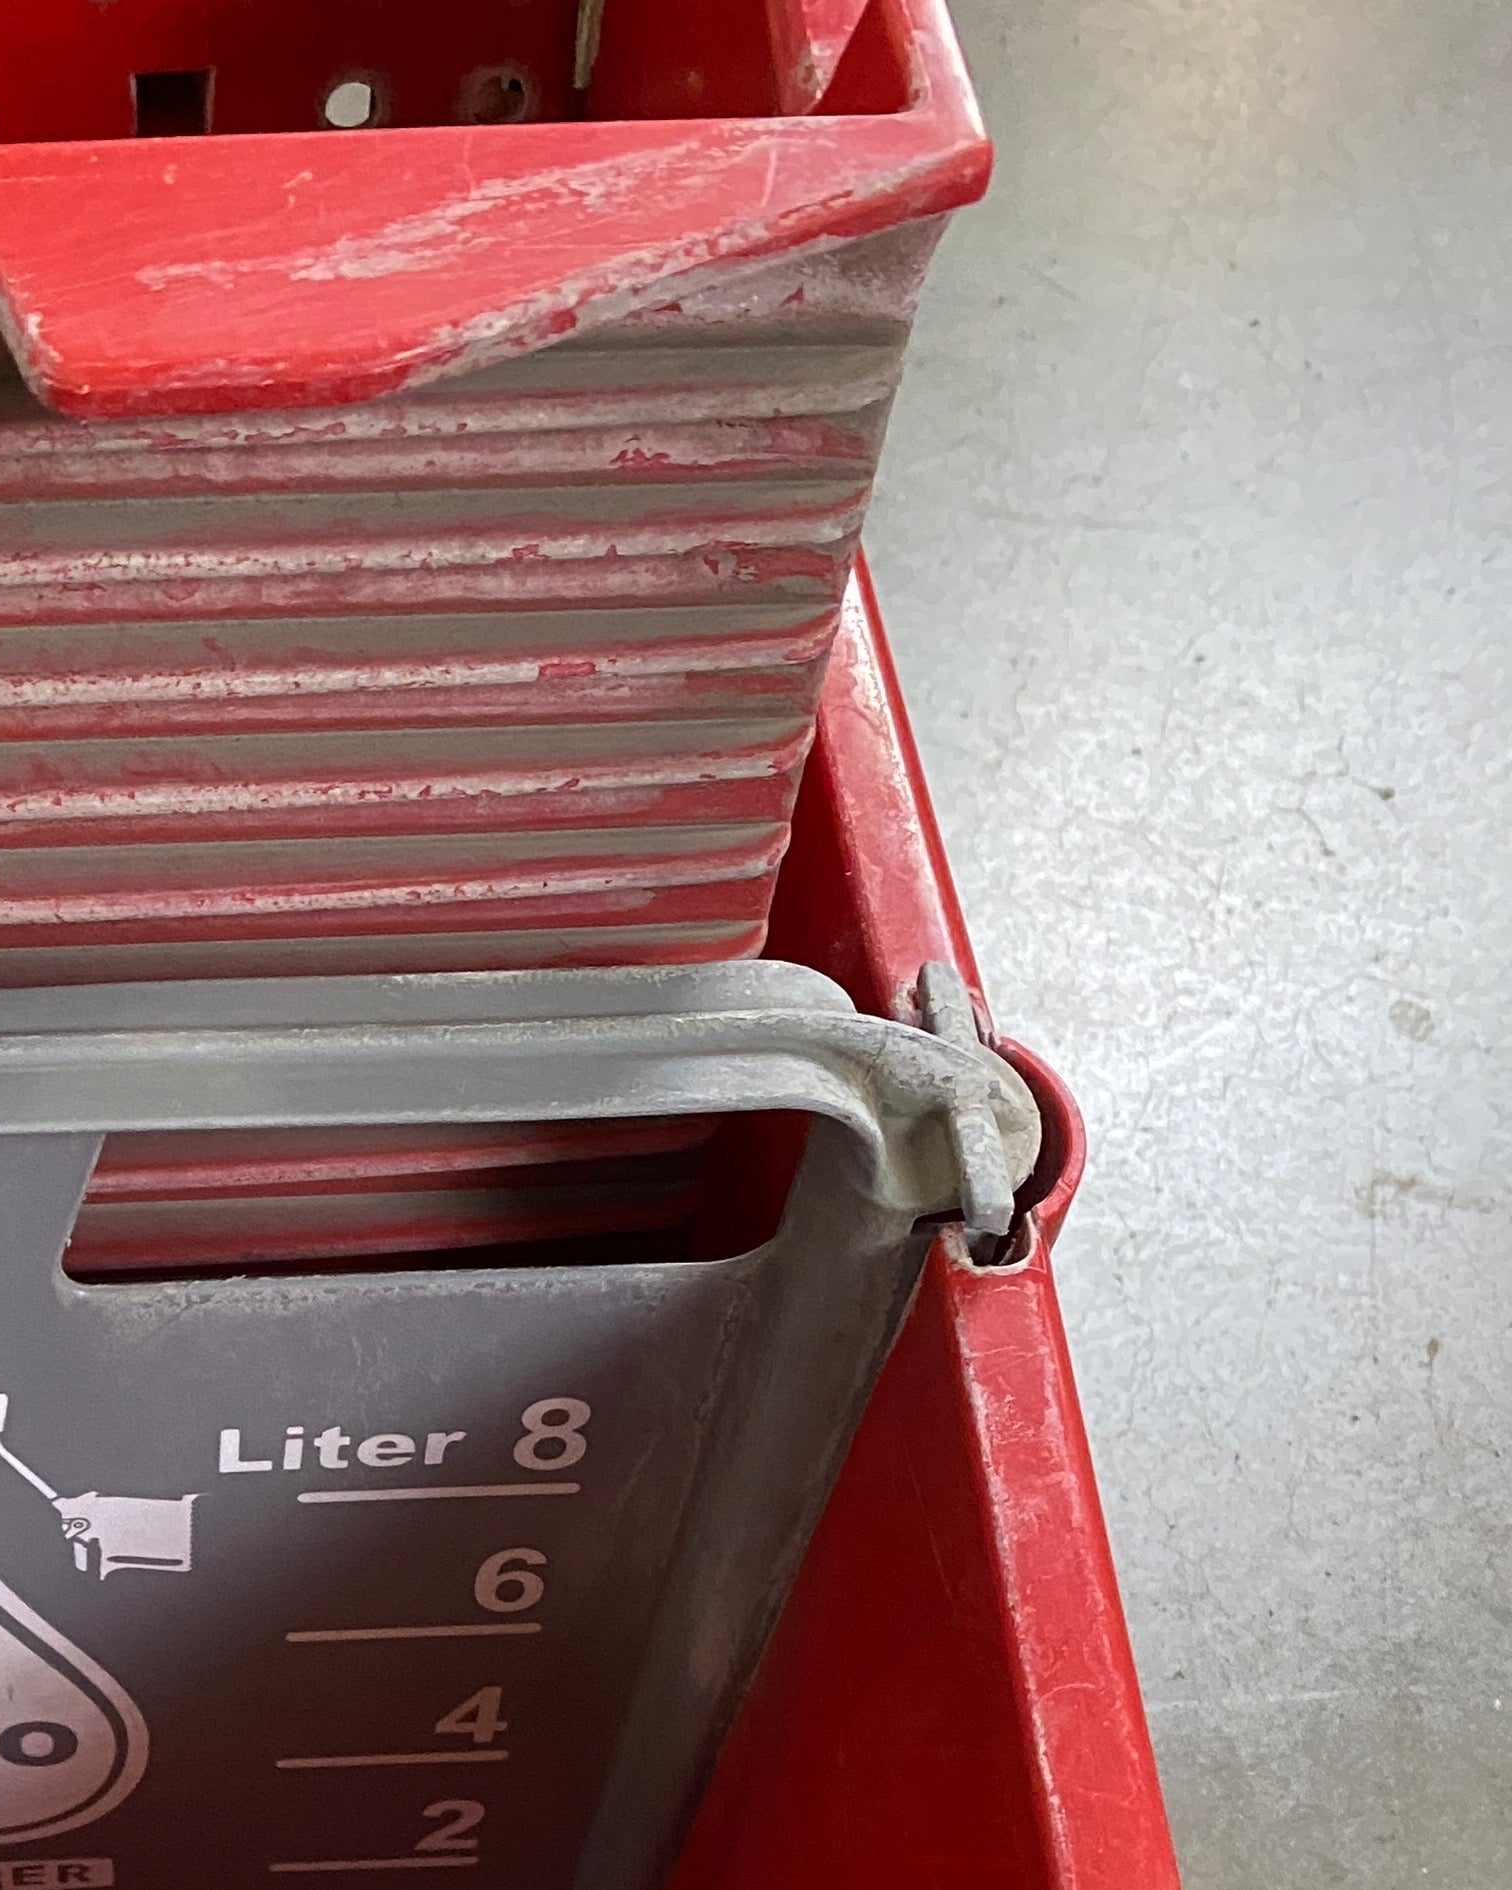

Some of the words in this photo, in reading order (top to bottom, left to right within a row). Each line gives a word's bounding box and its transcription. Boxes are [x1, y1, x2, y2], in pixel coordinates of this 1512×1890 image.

[219, 1425, 467, 1473] Liter
[512, 1398, 591, 1470] 8
[474, 1547, 547, 1612] 6
[434, 1685, 507, 1743] 4
[414, 1800, 485, 1851] 2
